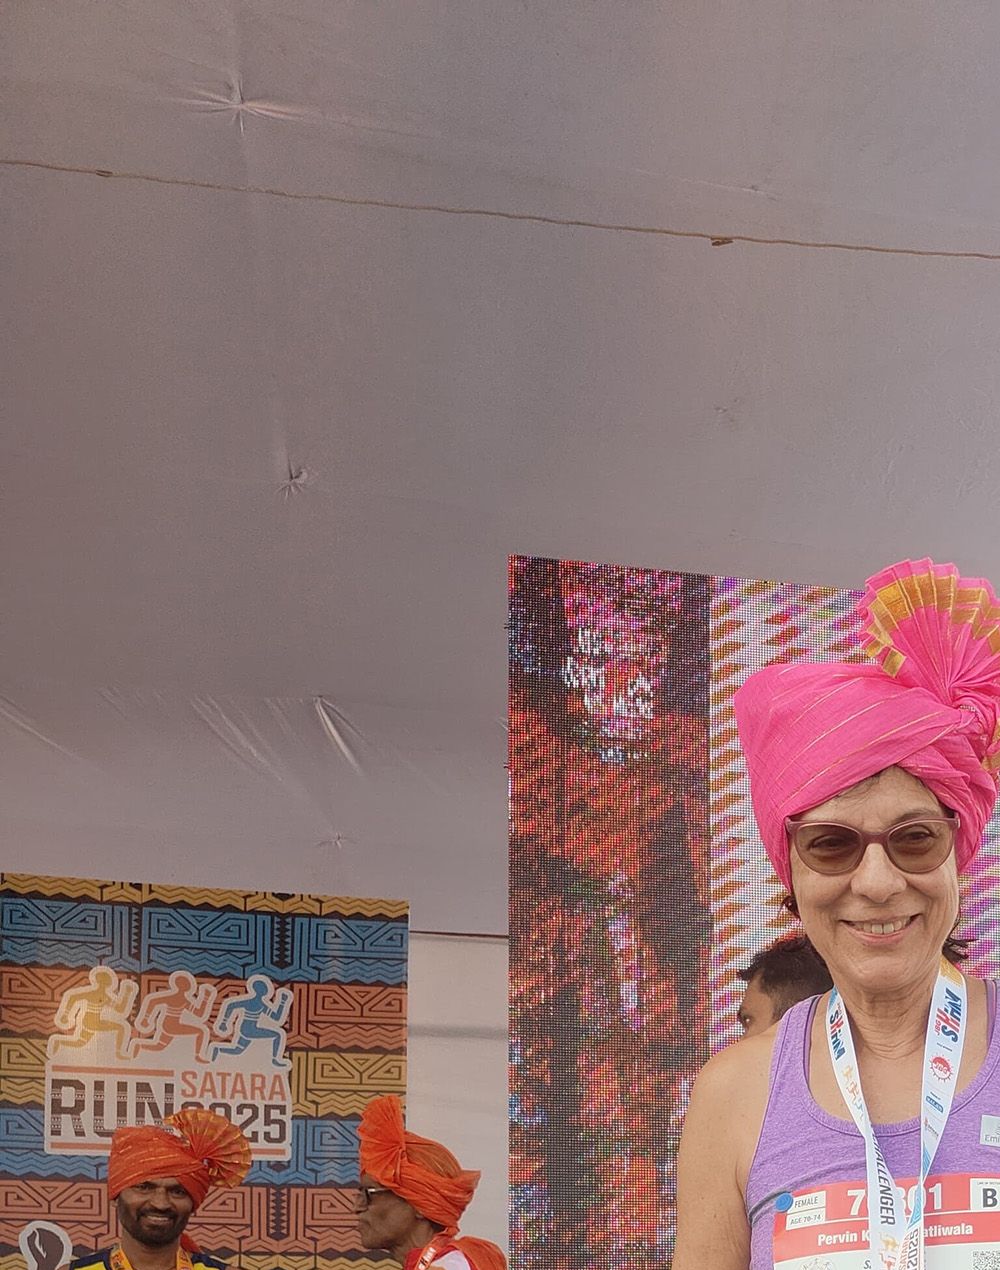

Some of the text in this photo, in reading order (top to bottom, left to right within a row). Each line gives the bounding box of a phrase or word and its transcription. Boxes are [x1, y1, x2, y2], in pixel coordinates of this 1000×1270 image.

[181, 1071, 286, 1101] SATARA
[50, 1078, 175, 1138] RUN
[180, 1101, 287, 1144] 25
[794, 1196, 818, 1208] FEMALE
[848, 1183, 943, 1216] 7301
[983, 1187, 998, 1208] B
[817, 1231, 858, 1246] Pervin
[923, 1223, 974, 1238] atliwala
[898, 1232, 910, 1270] SATARA
[906, 1227, 919, 1270] 2025
